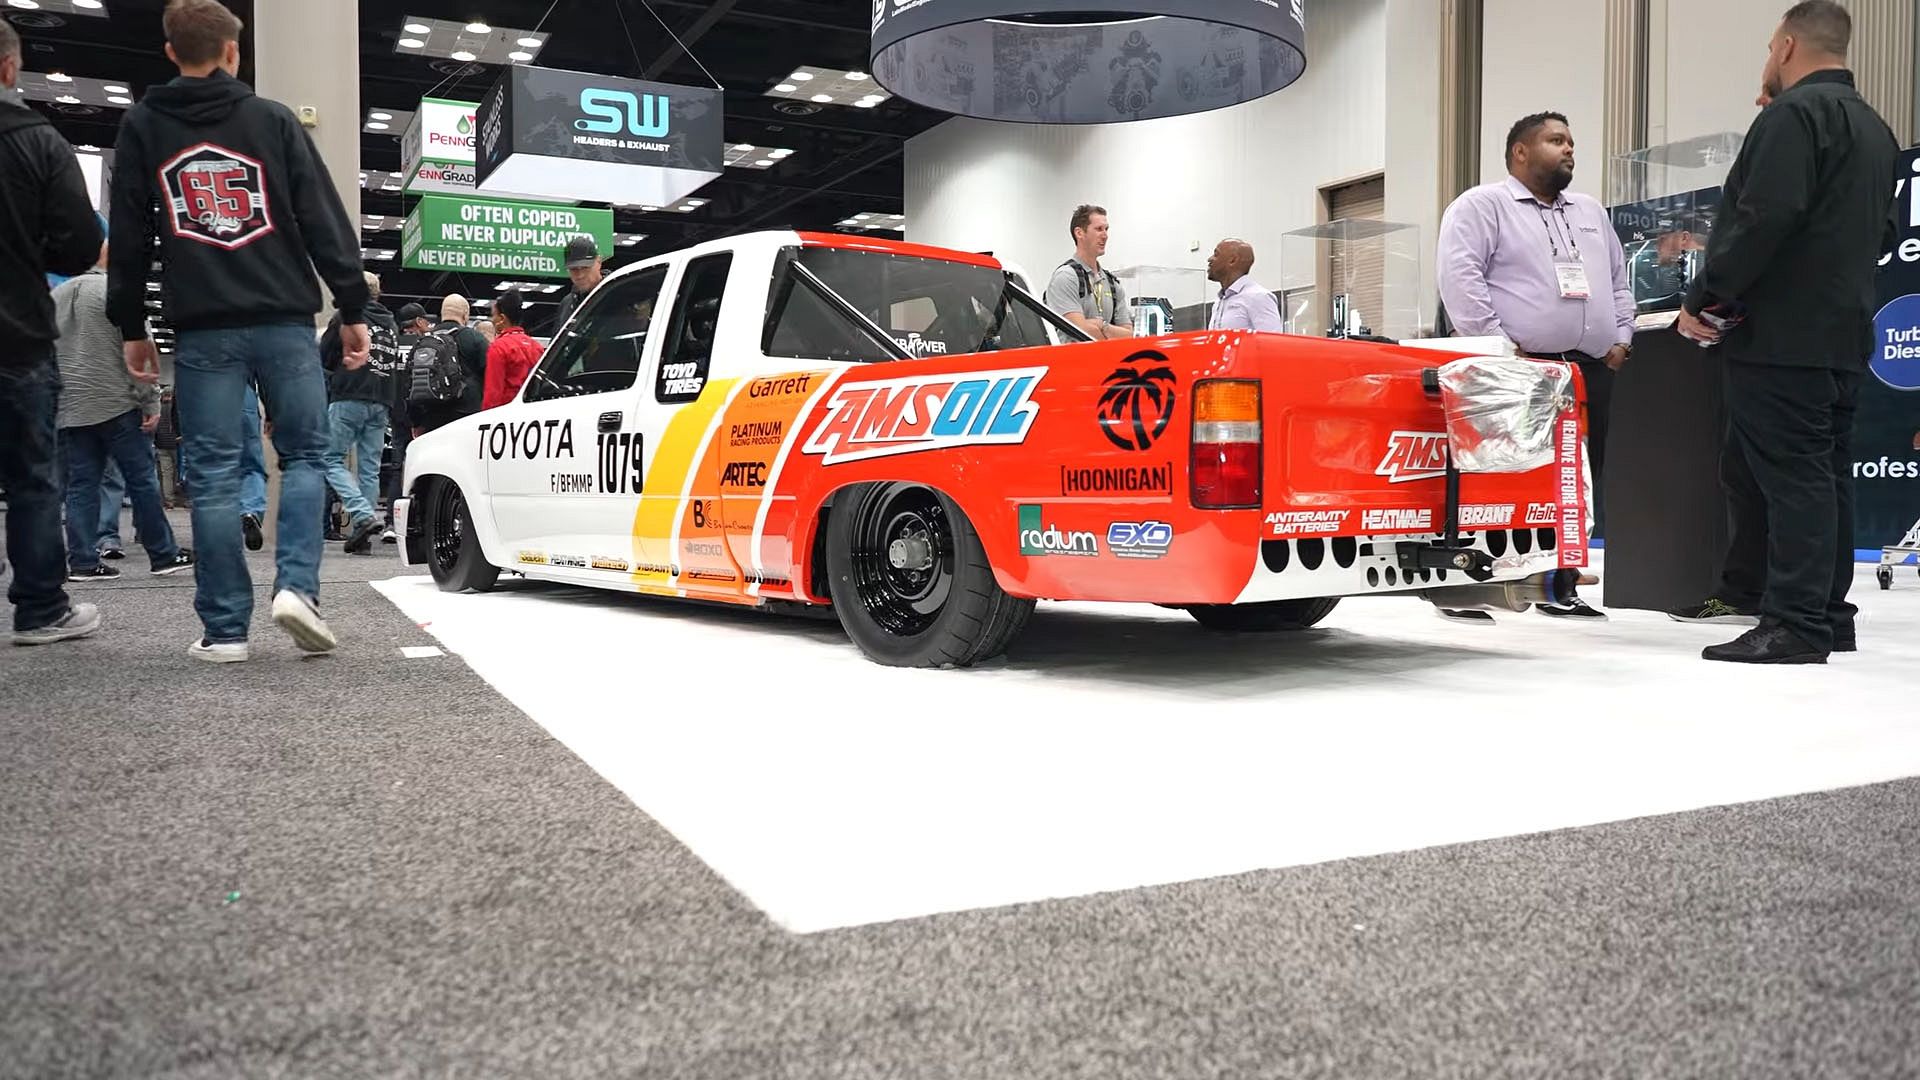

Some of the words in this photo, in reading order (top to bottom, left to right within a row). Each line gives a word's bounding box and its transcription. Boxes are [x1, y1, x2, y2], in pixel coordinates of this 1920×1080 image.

[574, 88, 669, 138] SW
[429, 132, 476, 147] PENNG
[573, 136, 617, 148] HEADERS
[619, 139, 626, 148] &
[627, 141, 670, 152] EXHAUST
[418, 169, 475, 183] ENNGRAD
[179, 167, 253, 221] 65
[460, 205, 513, 225] OFTEN
[518, 211, 580, 231] COPIED,
[441, 223, 495, 243] NEVER
[418, 250, 466, 267] NEVER
[471, 254, 560, 272] DUPLICATED.
[1885, 327, 1920, 343] Turb
[1884, 345, 1920, 360] Dies
[662, 362, 697, 379] TOYO
[664, 377, 704, 394] TIRES
[749, 376, 810, 398] Garrett
[809, 371, 1041, 460] AMSOIL
[478, 419, 574, 460] TOYOTA
[731, 421, 782, 438] PLATINUM
[730, 438, 750, 447] RACING
[751, 436, 781, 446] PRODUCTS
[1561, 420, 1577, 464] REMOVE
[597, 433, 644, 494] 1079
[1380, 433, 1448, 480] AMS
[1852, 456, 1920, 478] rofes
[720, 461, 766, 486] ARTEC
[1561, 467, 1578, 505] BEFORE
[1265, 510, 1350, 524] ANTIGRAVITY
[1273, 522, 1340, 534] BATTERIES
[1362, 509, 1431, 530] HEATWAVE
[1563, 508, 1579, 545] FLIGHT
[1020, 524, 1097, 552] radium
